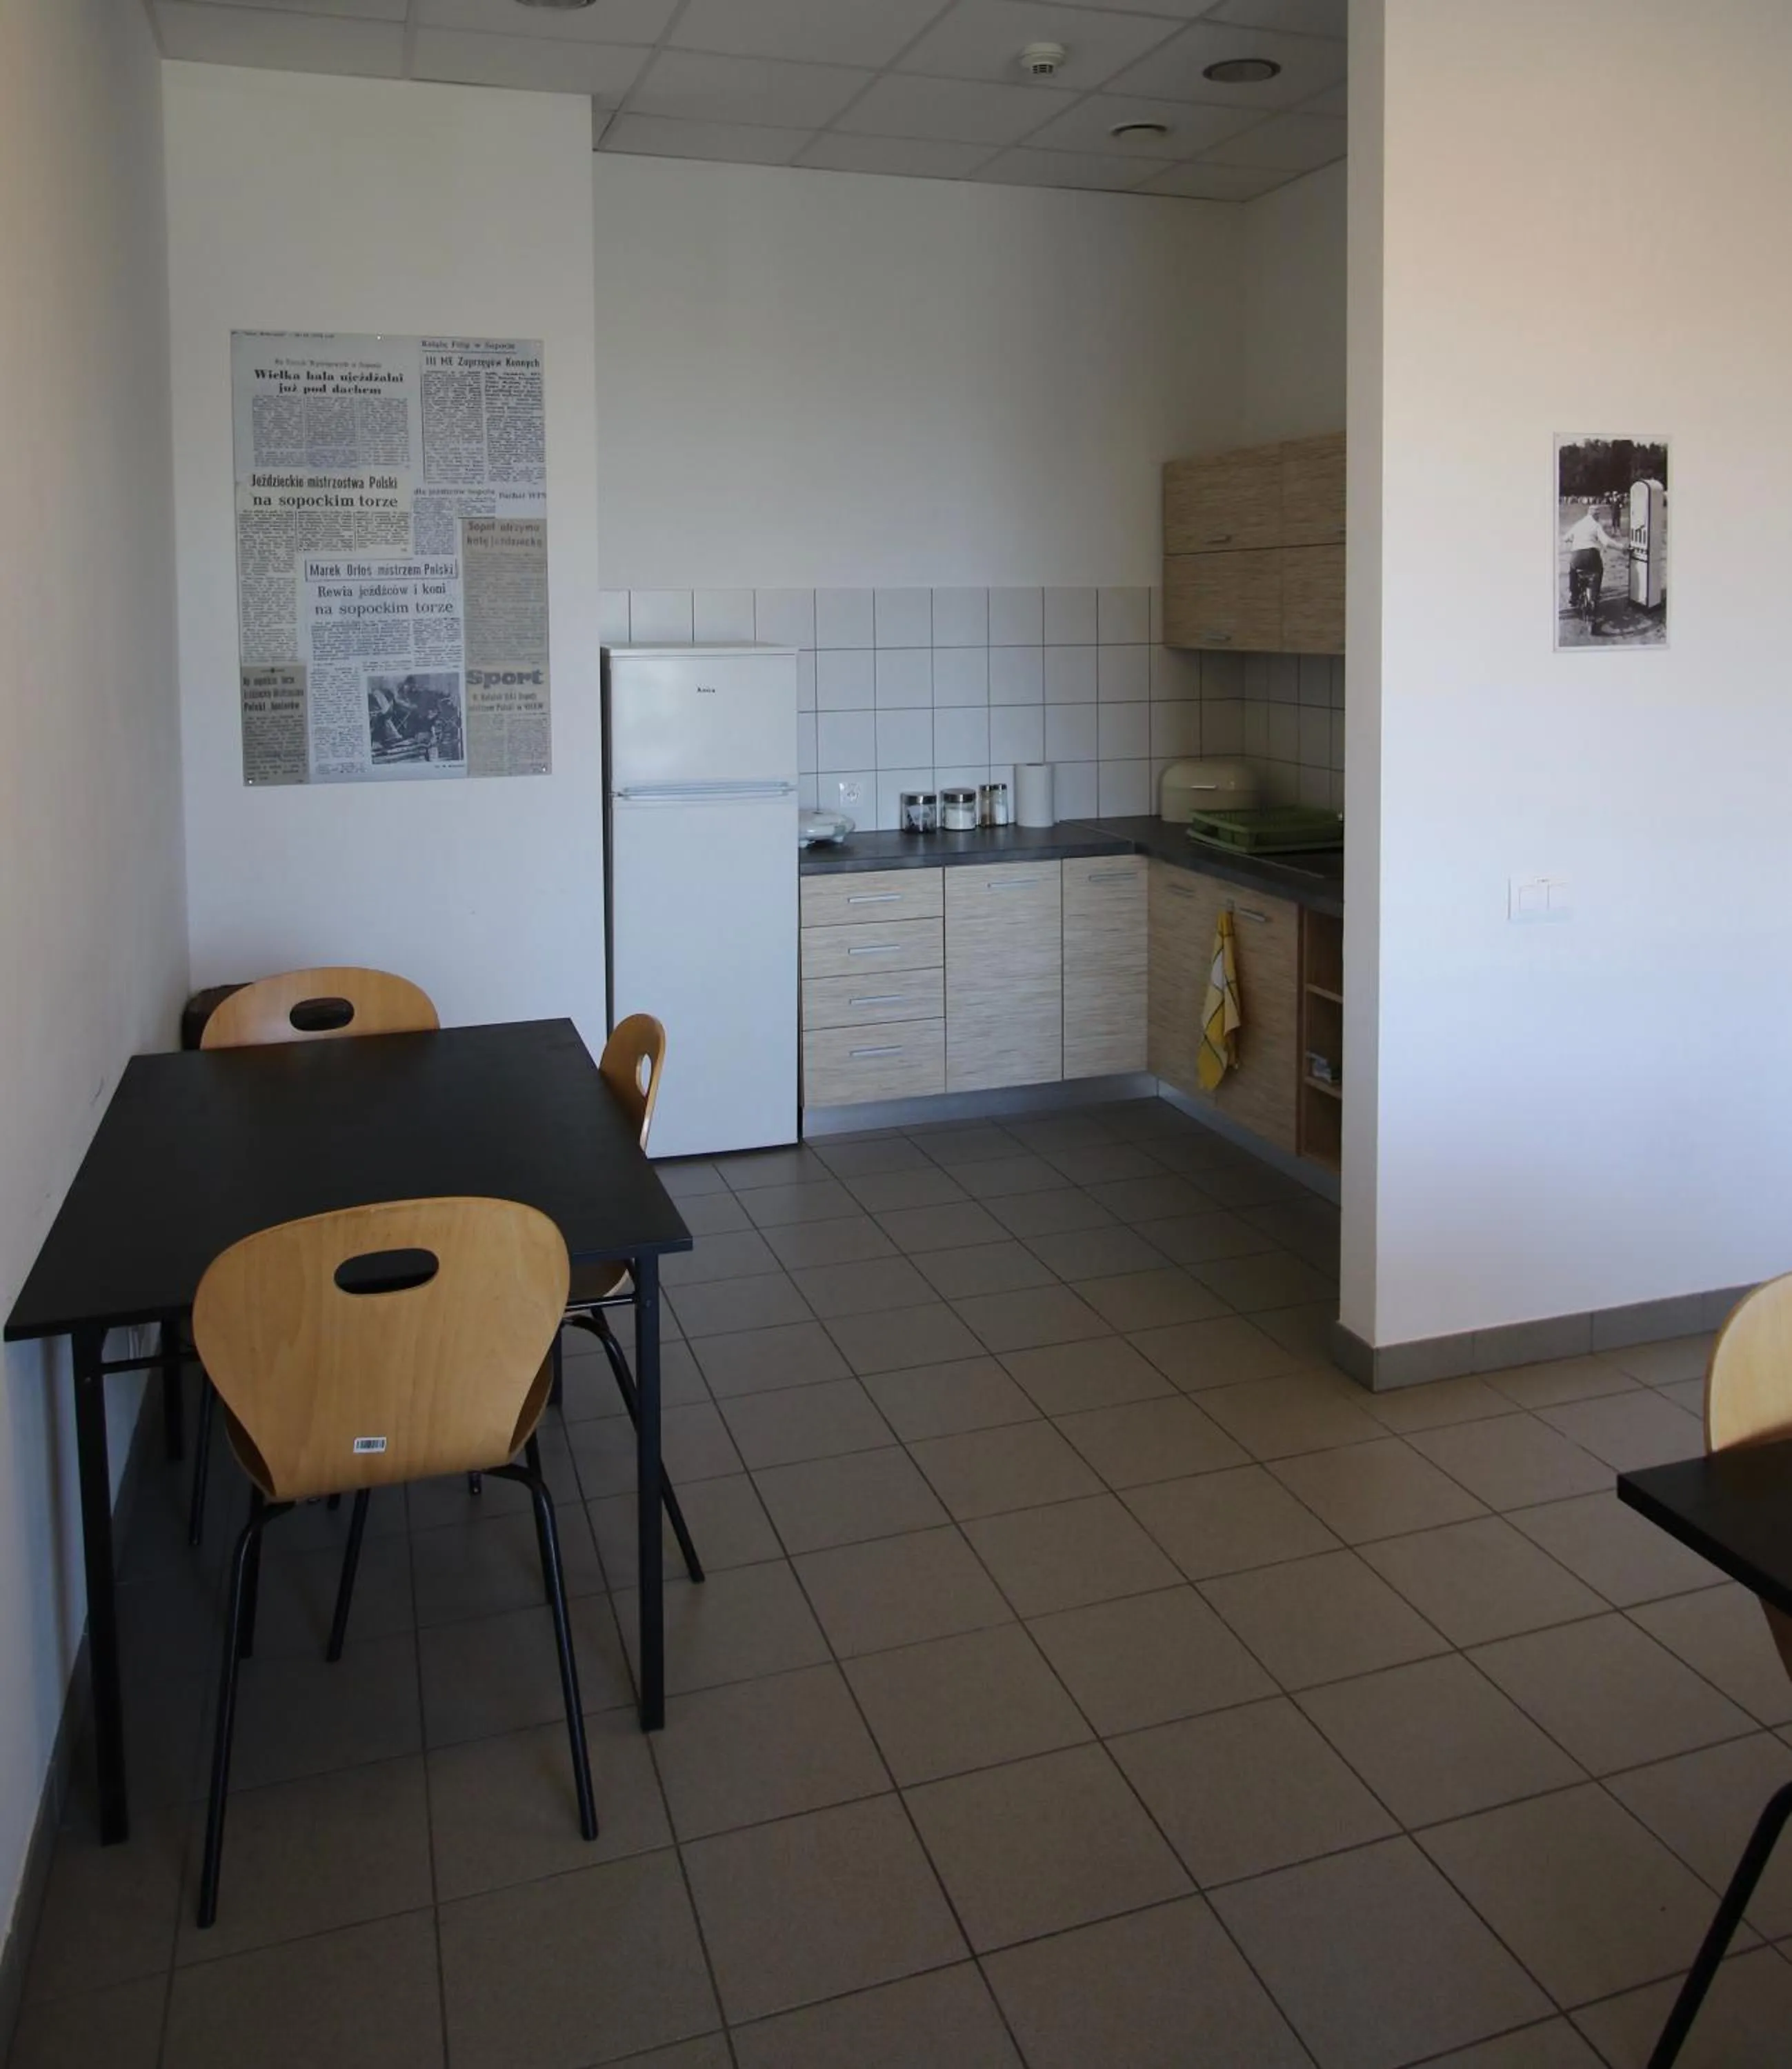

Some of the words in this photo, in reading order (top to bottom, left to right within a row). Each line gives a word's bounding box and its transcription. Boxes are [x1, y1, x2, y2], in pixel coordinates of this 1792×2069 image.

[255, 369, 300, 380] Wielka
[306, 370, 335, 381] hala
[303, 383, 326, 394] pod
[332, 384, 381, 395] dachem
[307, 476, 364, 489] mistrzostwa
[369, 475, 398, 489] Polski
[253, 495, 272, 506] na
[278, 494, 355, 509] sopockim
[359, 494, 398, 508] torze
[310, 563, 341, 577] Marek
[377, 563, 421, 577] mistrzem
[424, 563, 453, 576] Polski
[318, 586, 353, 598] Rewia
[413, 583, 418, 594] i
[422, 583, 446, 594] koni
[315, 605, 332, 615] na
[339, 601, 409, 617] sopockim
[415, 601, 454, 613] torze
[466, 668, 544, 690] Sport
